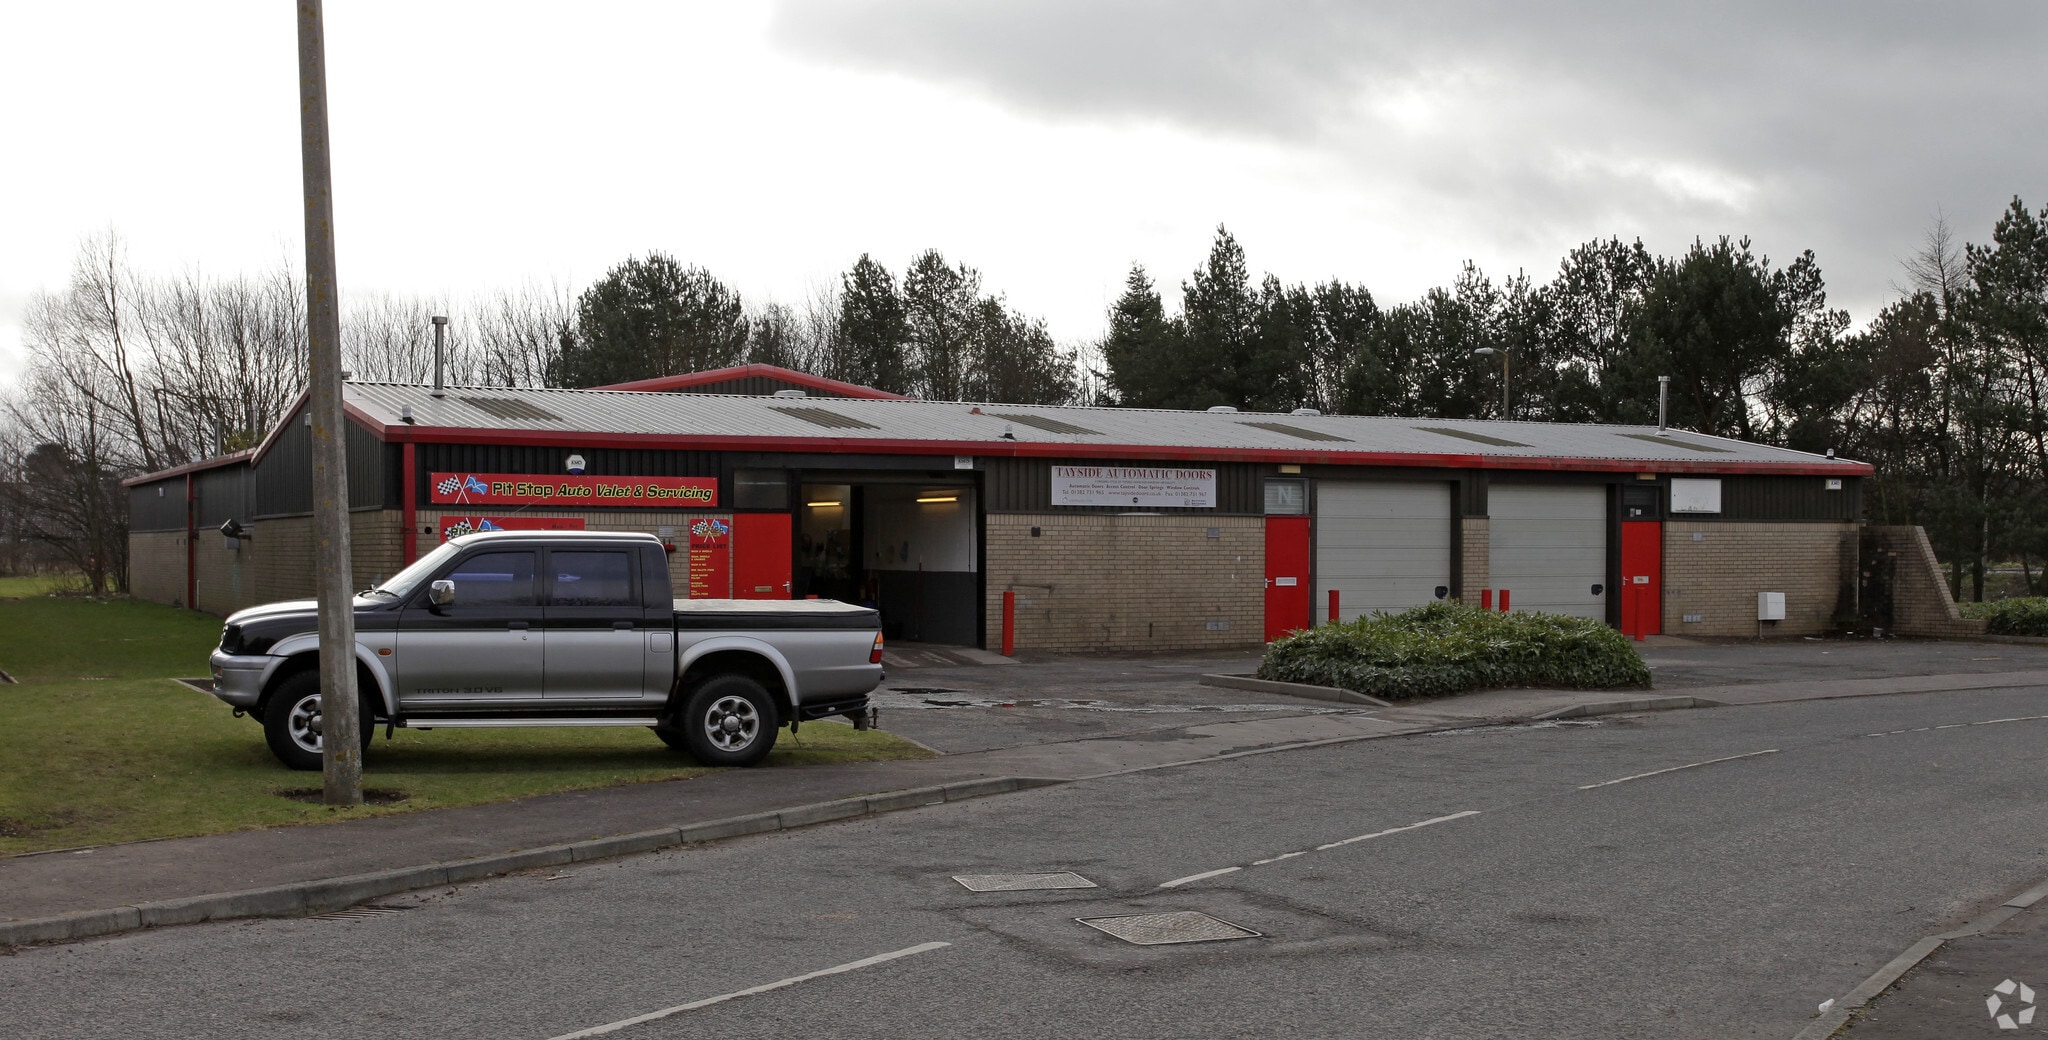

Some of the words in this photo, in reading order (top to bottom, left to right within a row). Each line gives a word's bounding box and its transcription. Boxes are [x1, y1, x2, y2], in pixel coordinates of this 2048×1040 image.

[1055, 467, 1103, 478] TAYSIDE
[1105, 467, 1173, 480] AUTOMATIC
[1176, 470, 1212, 481] DOORS
[492, 482, 514, 496] Pit
[516, 483, 553, 498] Stop
[557, 484, 592, 498] Auto
[596, 484, 631, 498] Valet
[633, 486, 643, 498] &
[647, 485, 713, 502] Servicing
